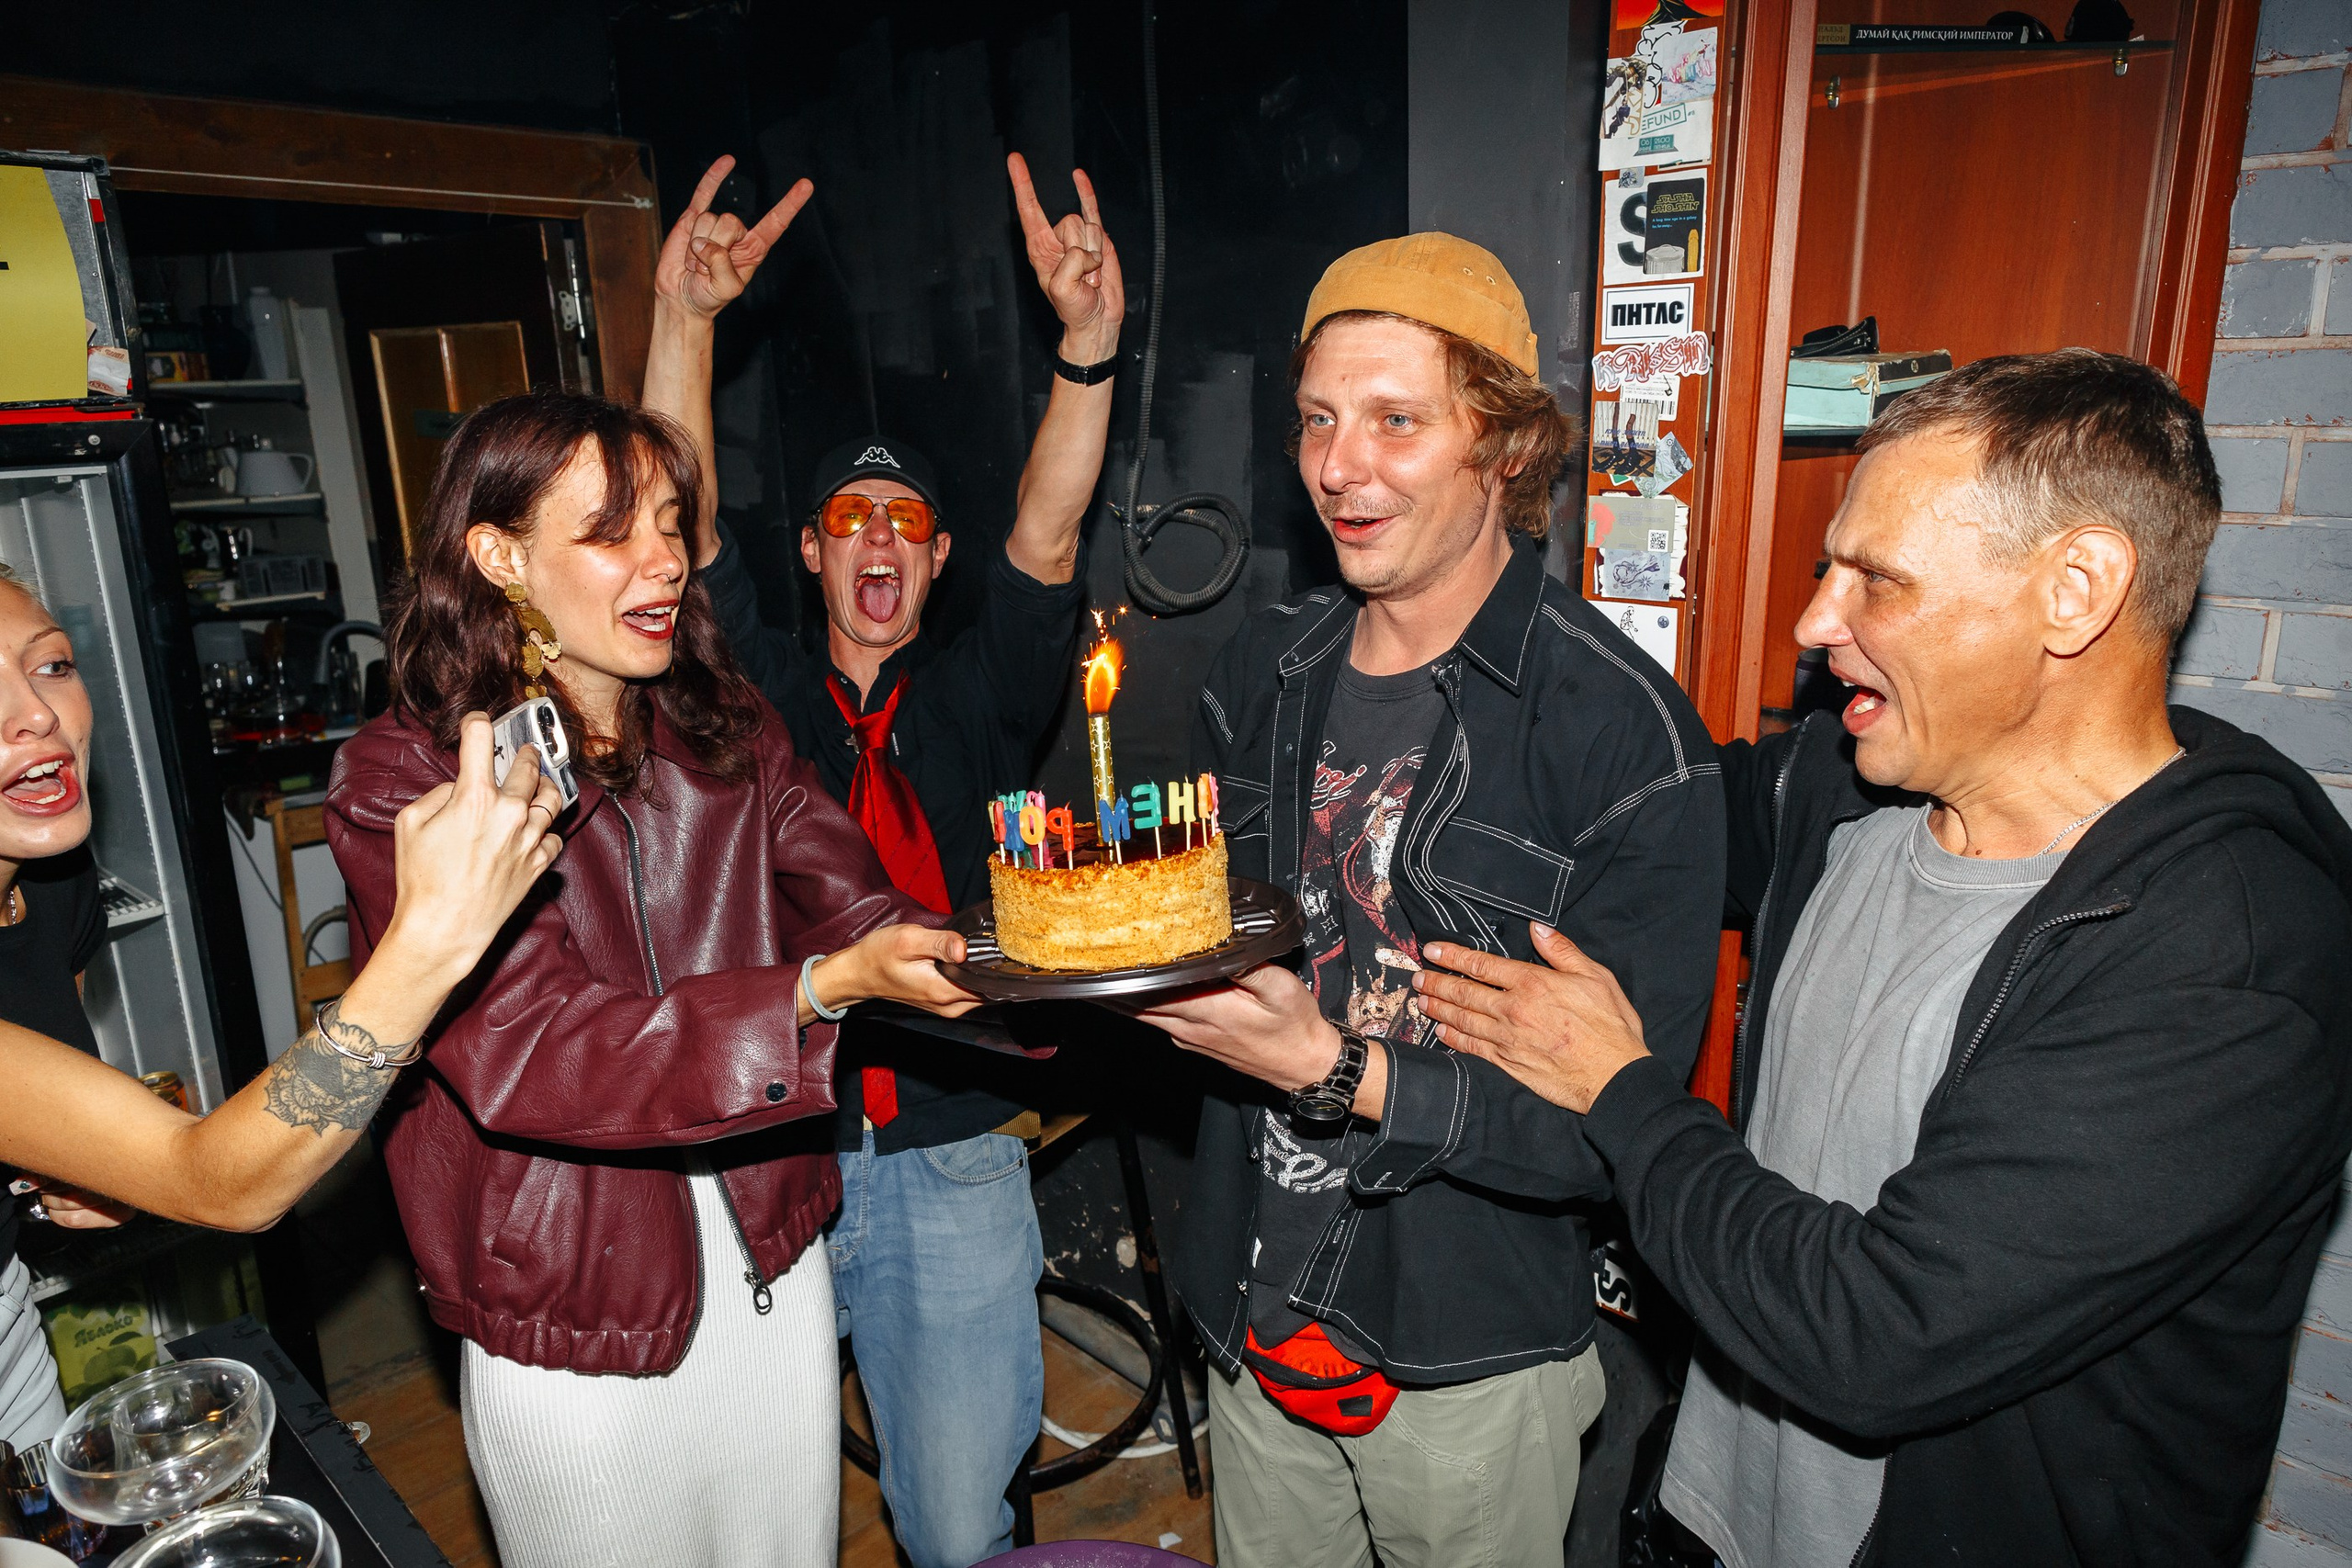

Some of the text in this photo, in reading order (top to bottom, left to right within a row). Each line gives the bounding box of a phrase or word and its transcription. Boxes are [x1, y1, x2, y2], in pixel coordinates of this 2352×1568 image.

[1856, 28, 2014, 41] ДУМАЙ КАК РИМСКИЙ ИМПЕРАТОР
[1657, 193, 1694, 204] SASHA
[1651, 201, 1700, 213] SHOSHIN
